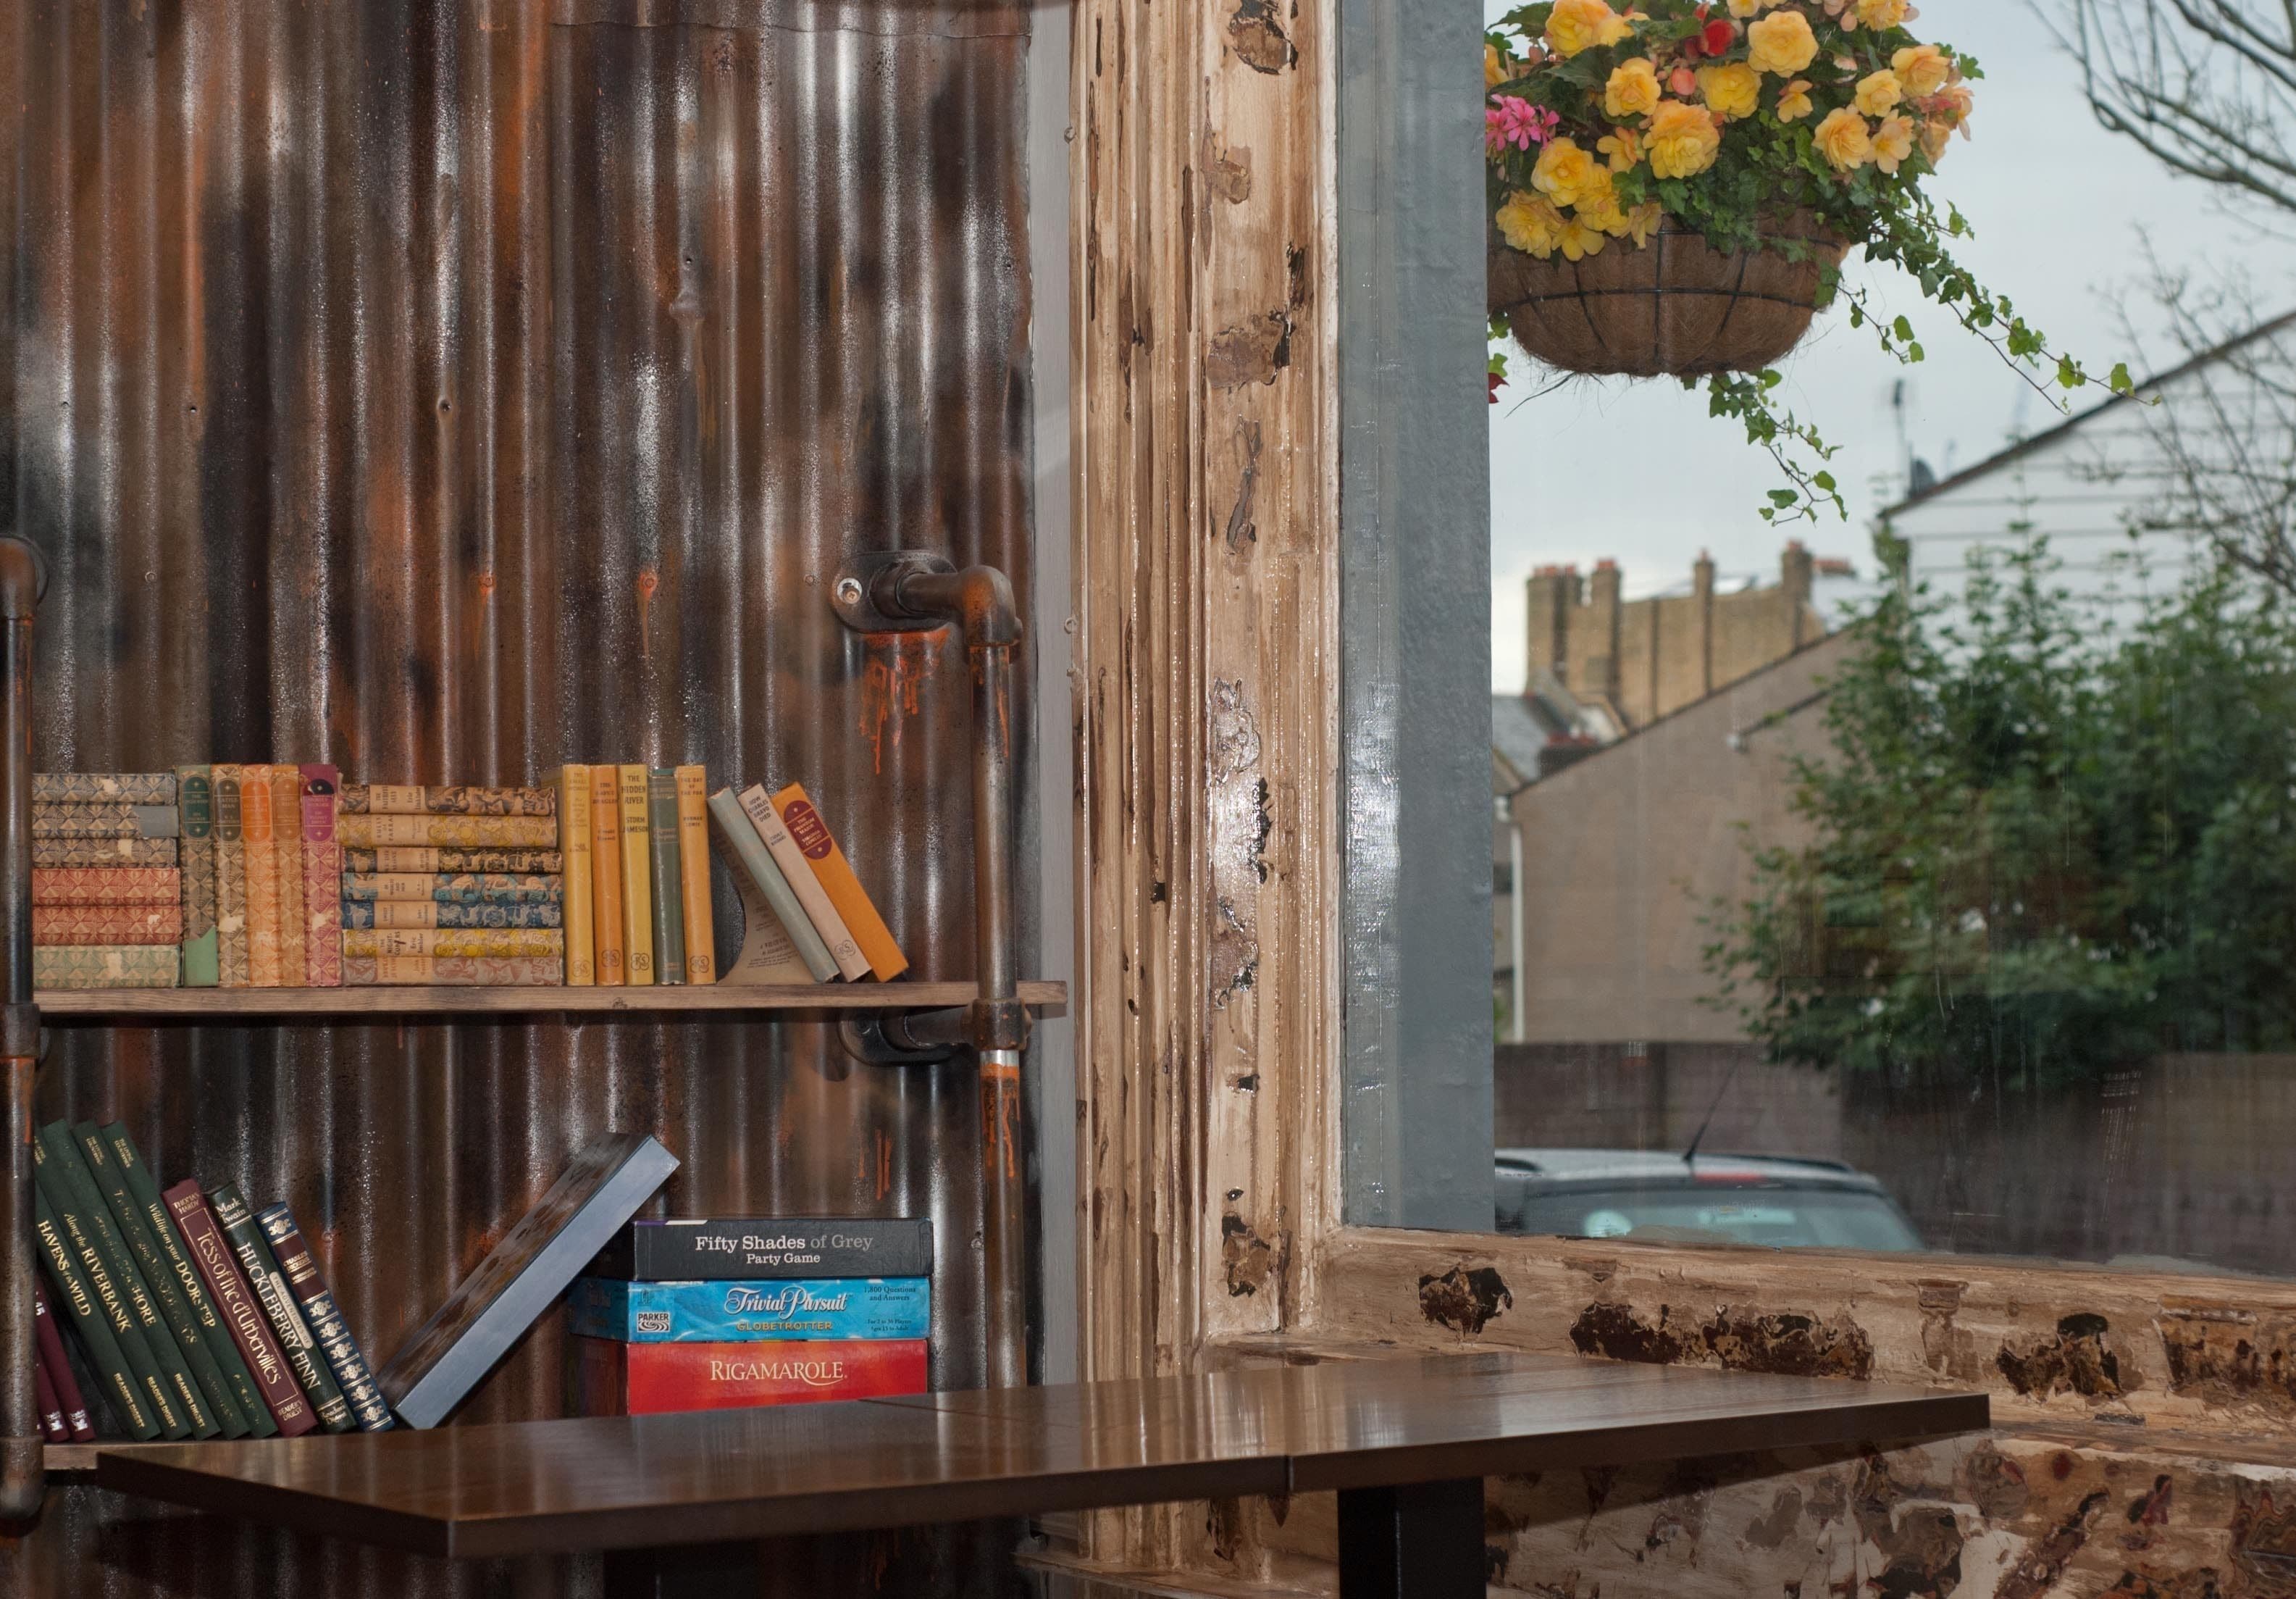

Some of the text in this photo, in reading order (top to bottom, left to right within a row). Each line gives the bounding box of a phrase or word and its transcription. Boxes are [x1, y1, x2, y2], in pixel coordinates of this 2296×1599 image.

[621, 785, 646, 794] HIDDEN
[747, 800, 769, 814] CHARLES
[760, 813, 771, 823] DIED
[172, 1193, 200, 1210] THOMAS
[178, 1200, 200, 1215] HARDY
[215, 1198, 241, 1215] Mark
[219, 1208, 247, 1224] Twain
[148, 1202, 169, 1236] Wildlife
[166, 1241, 180, 1261] your
[197, 1226, 222, 1265] Tess
[695, 1234, 874, 1253] Fifty Shades of Grey
[38, 1219, 70, 1272] HAVENS
[68, 1279, 92, 1316] WILD
[746, 1253, 821, 1266] Party Game
[64, 1213, 80, 1238] Along
[81, 1246, 133, 1333] RIVERBANK
[213, 1261, 233, 1279] of
[219, 1275, 240, 1303] the
[724, 1285, 848, 1320] Trivial Pursuit
[236, 1241, 303, 1350] HUCKLEBERRY
[291, 1350, 322, 1390] FINN
[637, 1313, 670, 1322] PARKER
[737, 1321, 834, 1332] GLOBETROTTER
[232, 1301, 281, 1385] d'Urbervilles
[710, 1360, 845, 1387] RIGAMAROLE
[114, 1372, 146, 1428] READER'S DIGEST
[146, 1376, 177, 1428] READER'S DIGEST
[174, 1372, 206, 1428] READER'S DIGEST
[277, 1400, 303, 1416] READER'S
[283, 1408, 303, 1421] DIGEST
